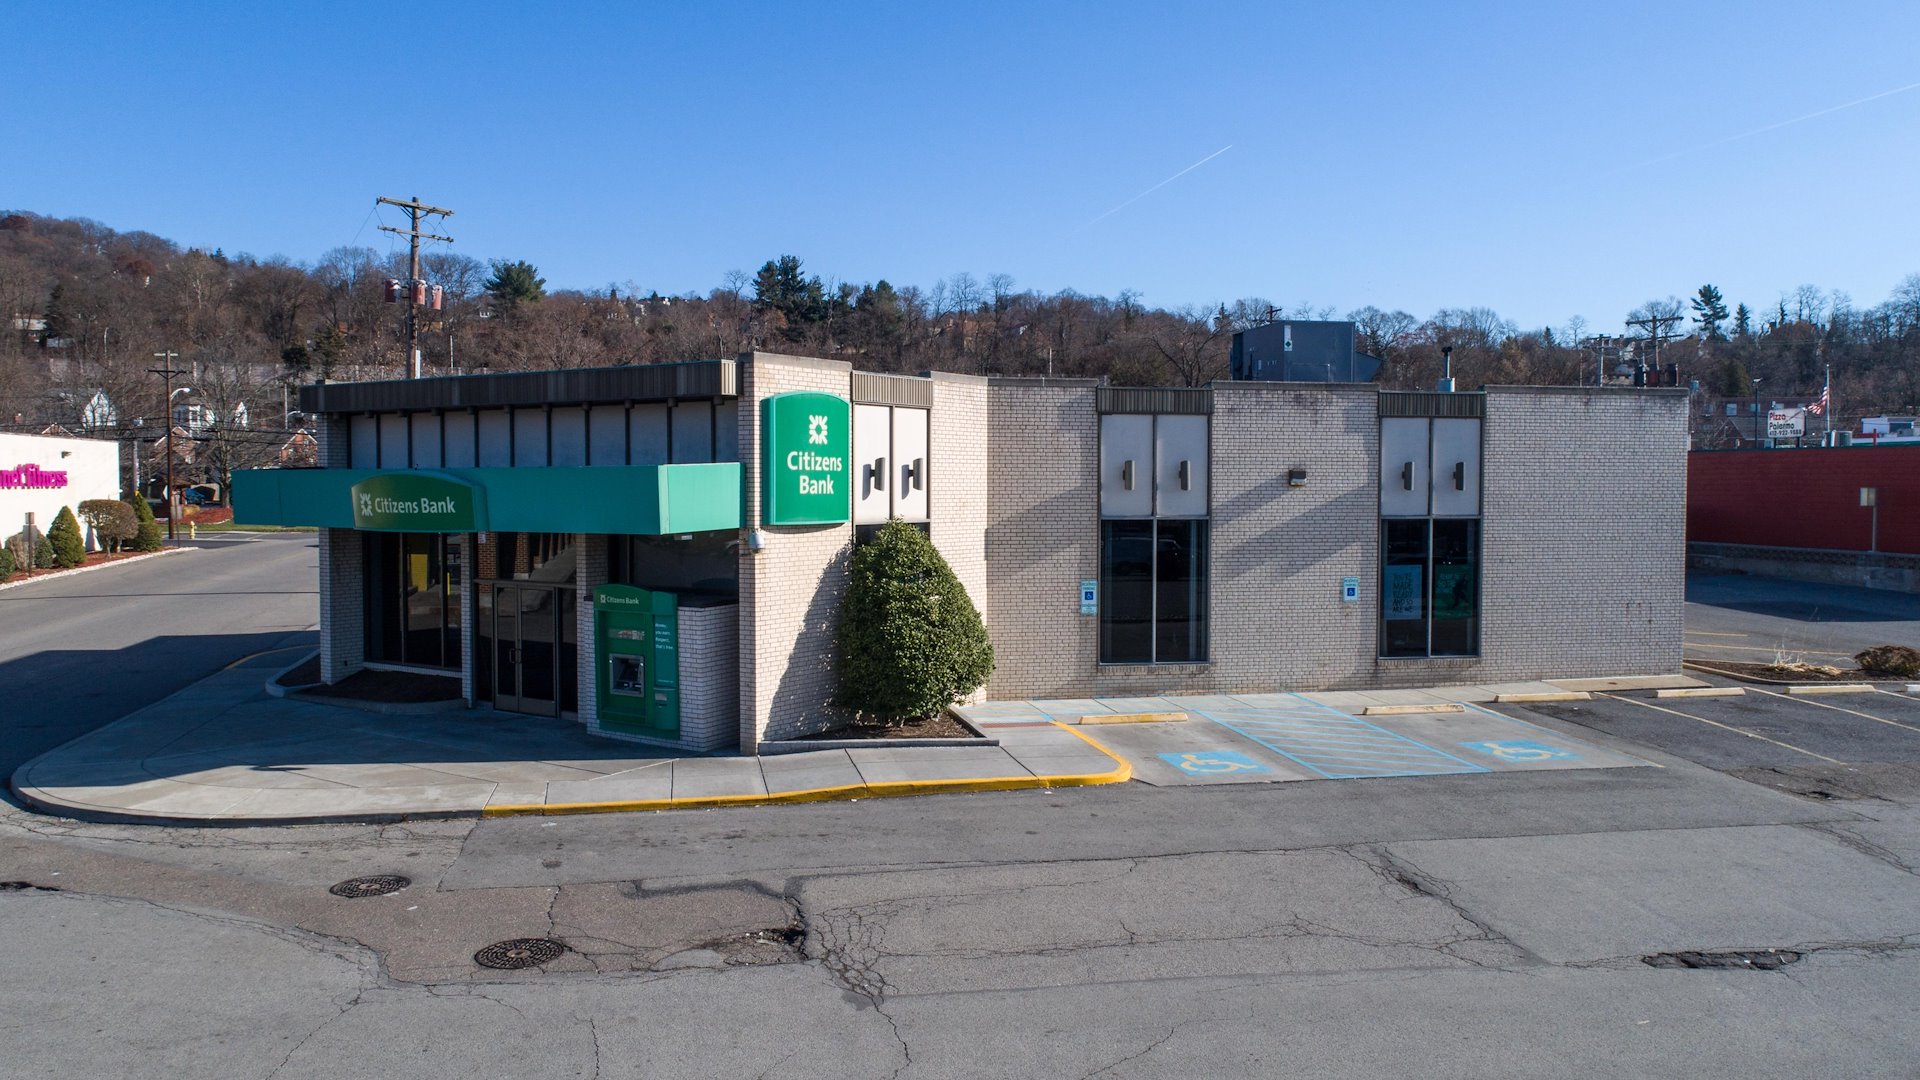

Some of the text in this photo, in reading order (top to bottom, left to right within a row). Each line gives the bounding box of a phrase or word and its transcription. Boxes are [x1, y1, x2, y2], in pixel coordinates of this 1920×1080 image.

[1769, 411, 1787, 421] Pizza
[1769, 422, 1795, 430] Palermo
[787, 451, 843, 471] Citizens
[799, 474, 835, 495] Bank
[374, 496, 456, 514] Citizens Bank
[606, 596, 625, 604] Citizens
